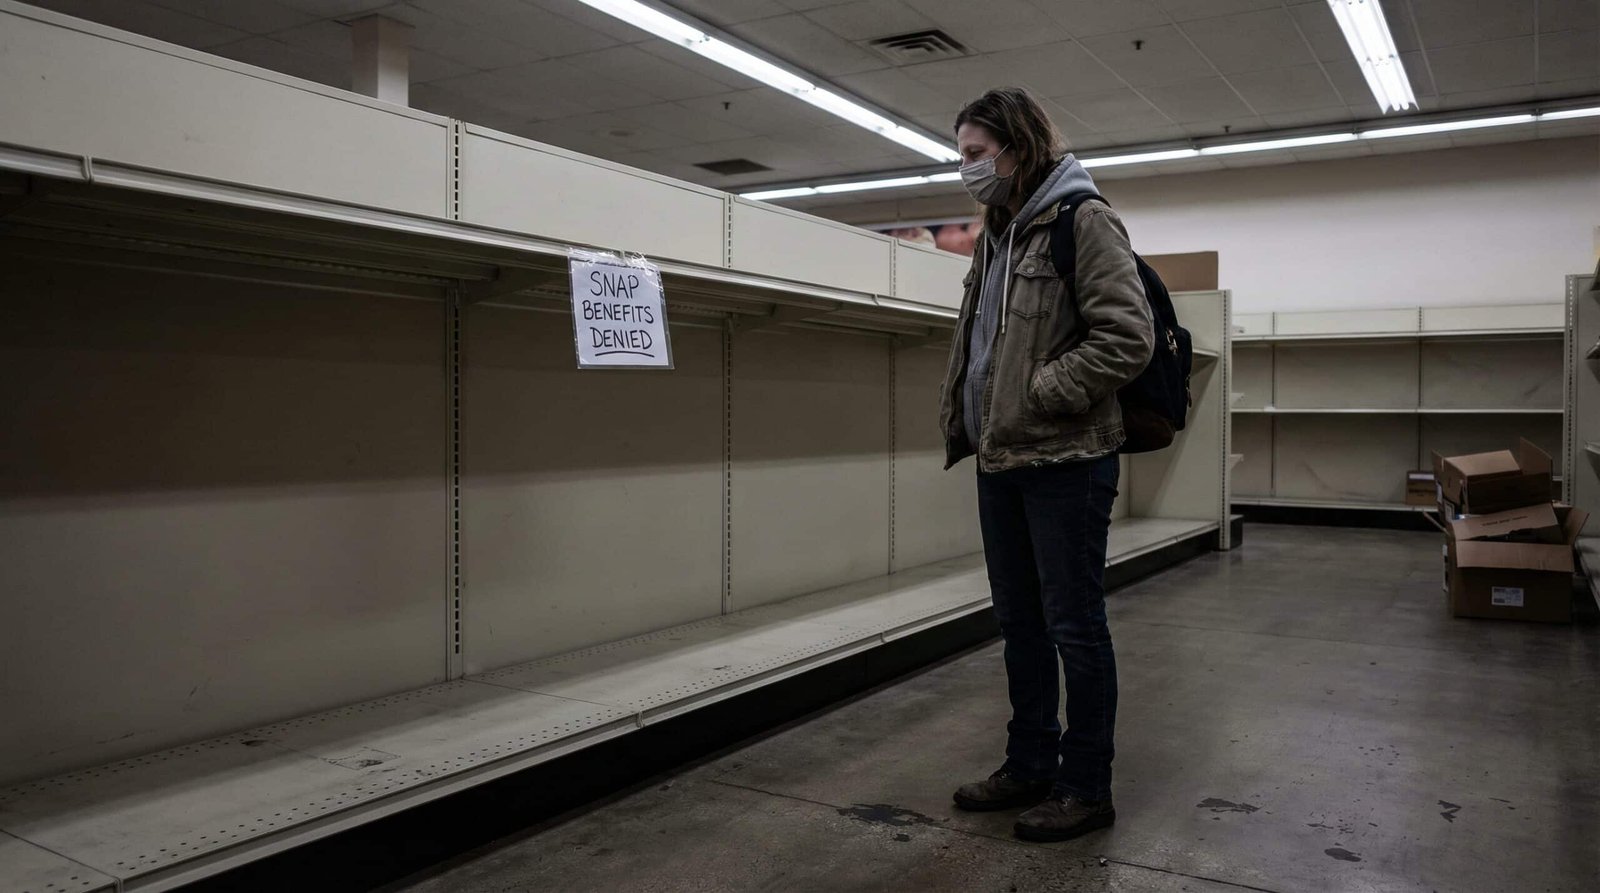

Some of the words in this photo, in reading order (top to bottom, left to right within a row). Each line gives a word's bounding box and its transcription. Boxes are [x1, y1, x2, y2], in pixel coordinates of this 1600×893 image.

[590, 270, 640, 299] SNAP
[582, 299, 655, 324] BENEFITS
[589, 326, 653, 350] DENIED
